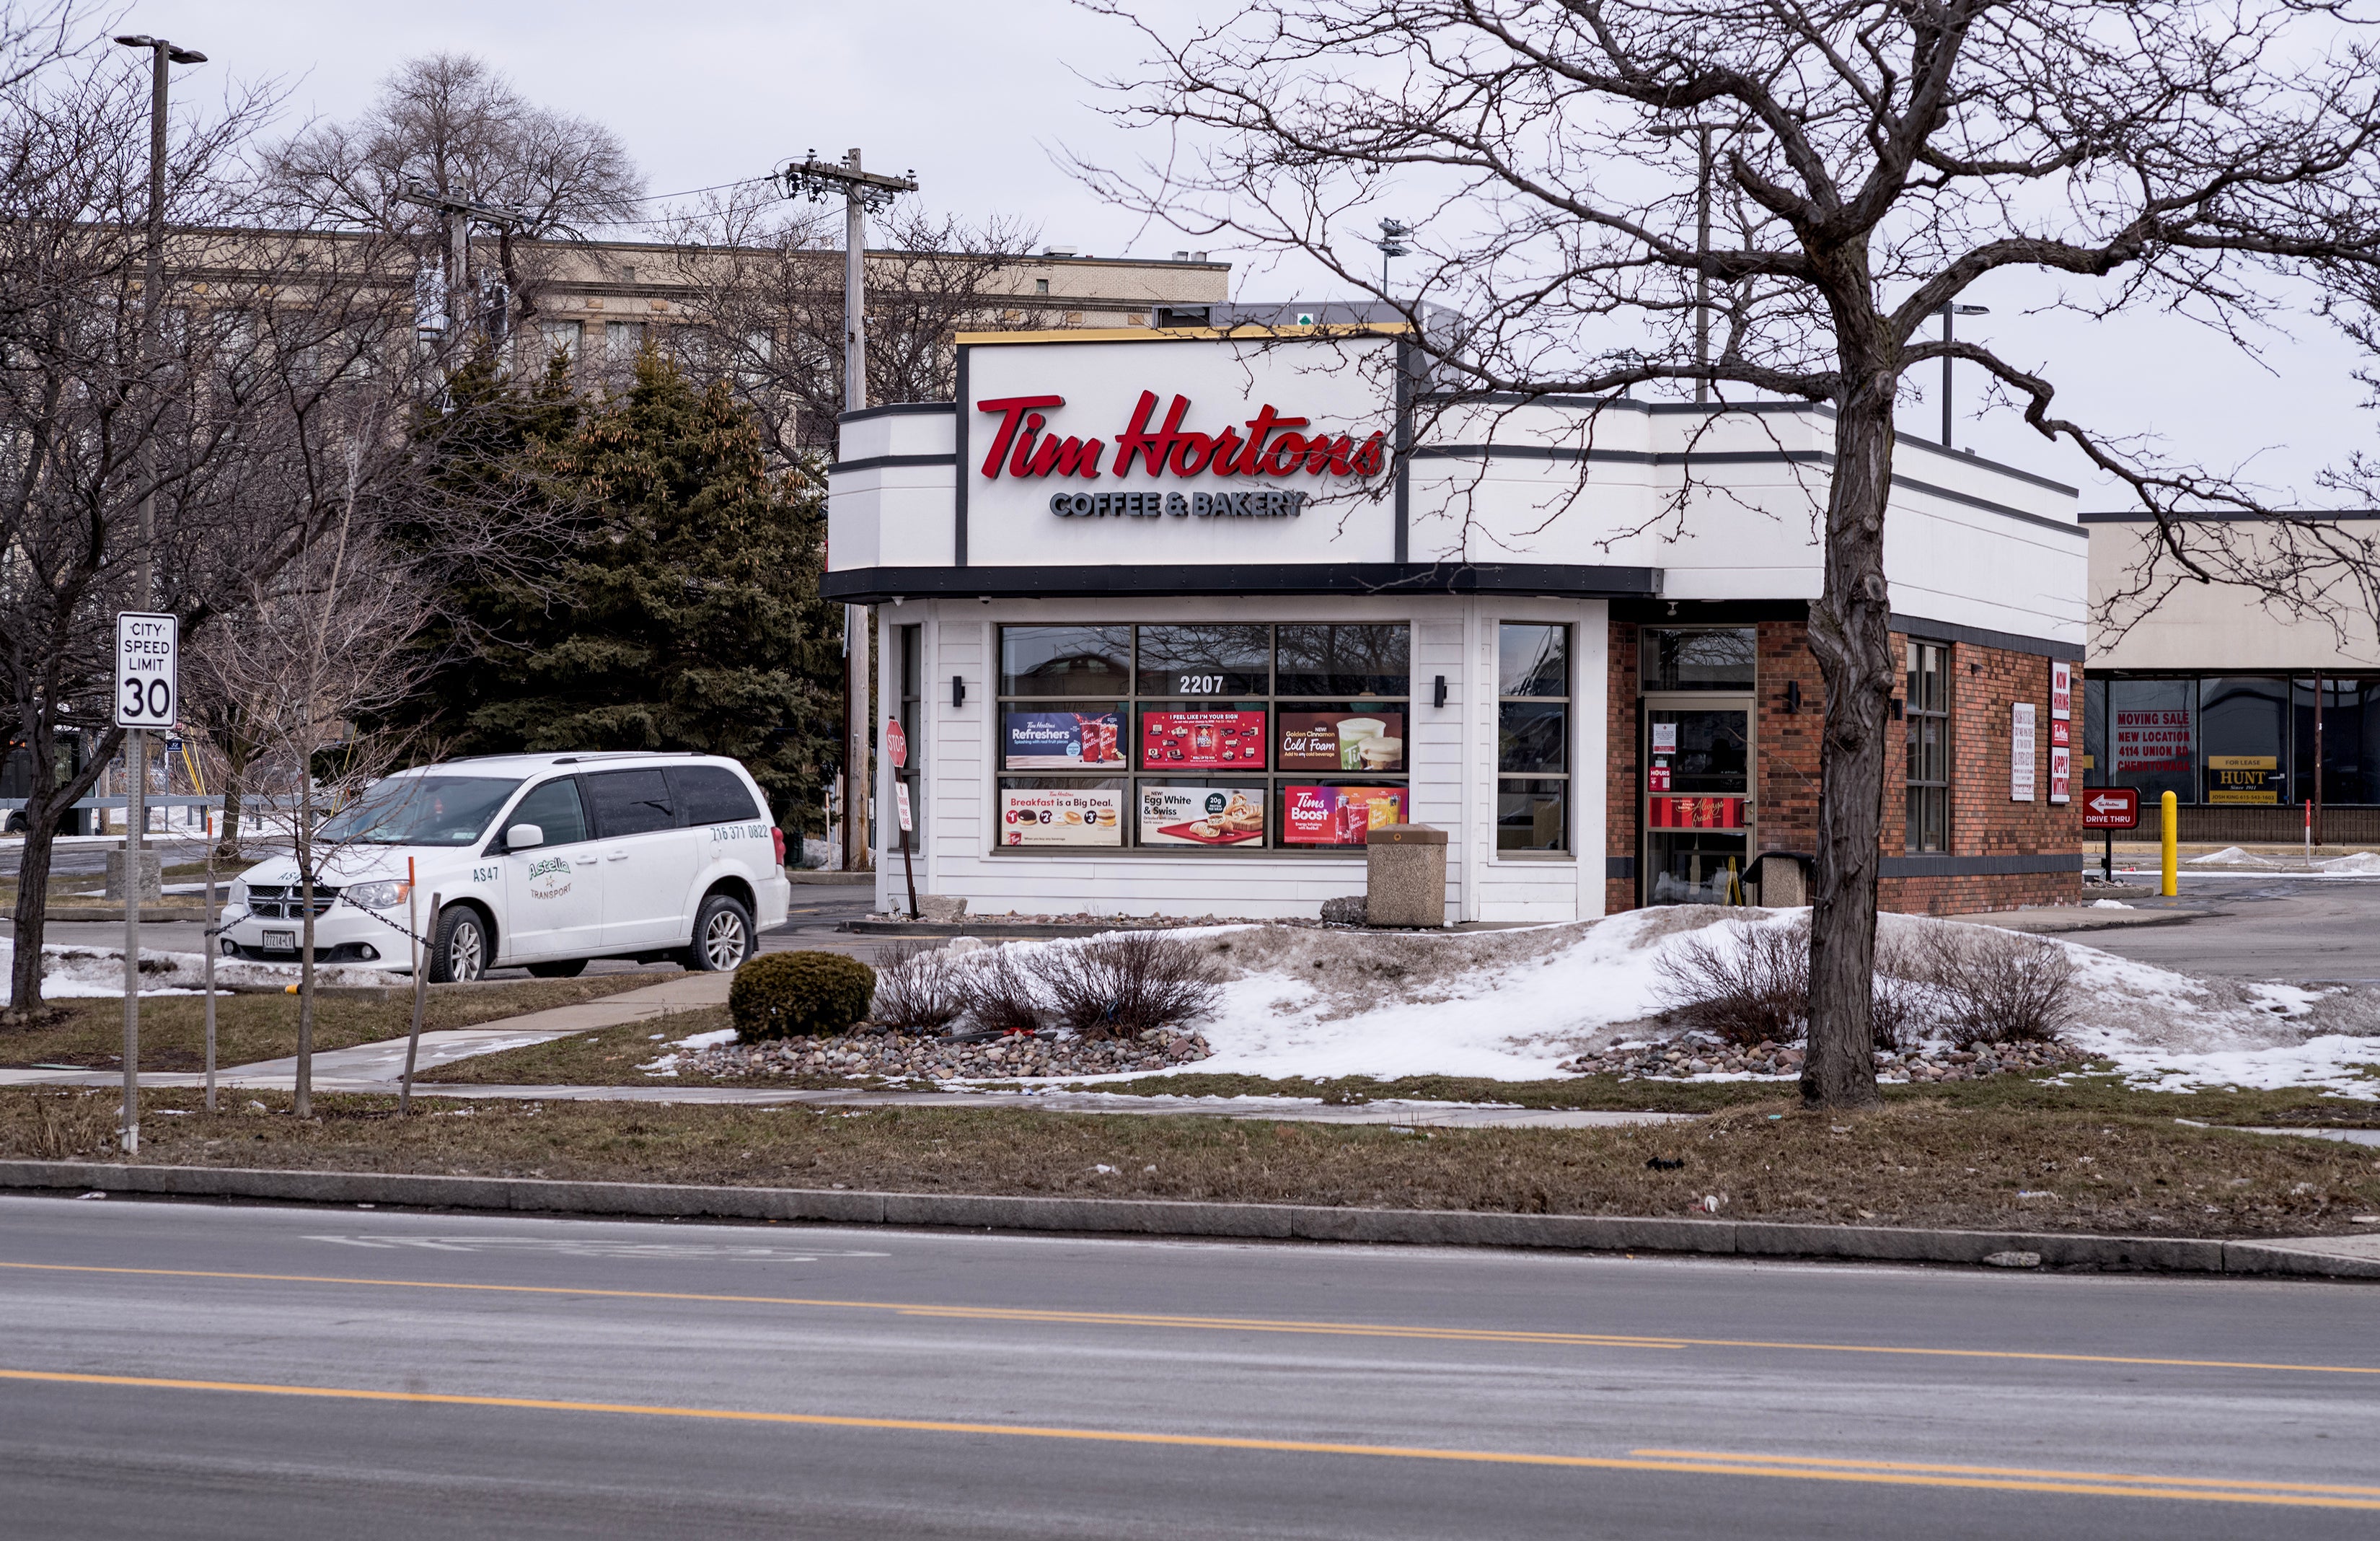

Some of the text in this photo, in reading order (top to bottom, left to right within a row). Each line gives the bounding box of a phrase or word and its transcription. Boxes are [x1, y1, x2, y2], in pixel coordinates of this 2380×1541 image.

[977, 389, 1387, 480] Tim Hortons
[1049, 491, 1306, 518] COFFEE & BAKERY
[132, 623, 162, 636] CITY
[125, 640, 169, 654] SPEED
[129, 658, 164, 671] LIMIT
[1180, 675, 1223, 693] 2207
[2056, 671, 2067, 689] NOW
[123, 677, 169, 718] 30
[2054, 692, 2068, 711] HIRING
[2117, 713, 2189, 725] MOVING SALE
[1013, 729, 1070, 739] Refreshers
[1083, 730, 1093, 741] Tim
[2118, 732, 2190, 742] NEW LOCATION
[888, 734, 904, 752] STOP
[1284, 737, 1335, 751] Cold Foam
[2119, 746, 2188, 756] 4114 UNION RD
[2054, 755, 2068, 773] APPLY
[2220, 771, 2265, 784] HUNT
[2053, 778, 2069, 795] WITHIN
[1074, 799, 1087, 808] Big
[1145, 796, 1191, 805] Egg White
[1297, 792, 1324, 808] Tims
[1689, 798, 1724, 815] Always
[1291, 807, 1328, 820] Boost
[1692, 813, 1711, 827] fresh
[710, 825, 767, 840] 716 371 0822
[474, 867, 498, 882] AS47
[529, 857, 570, 880] Astella
[531, 883, 571, 900] TRANSPORT
